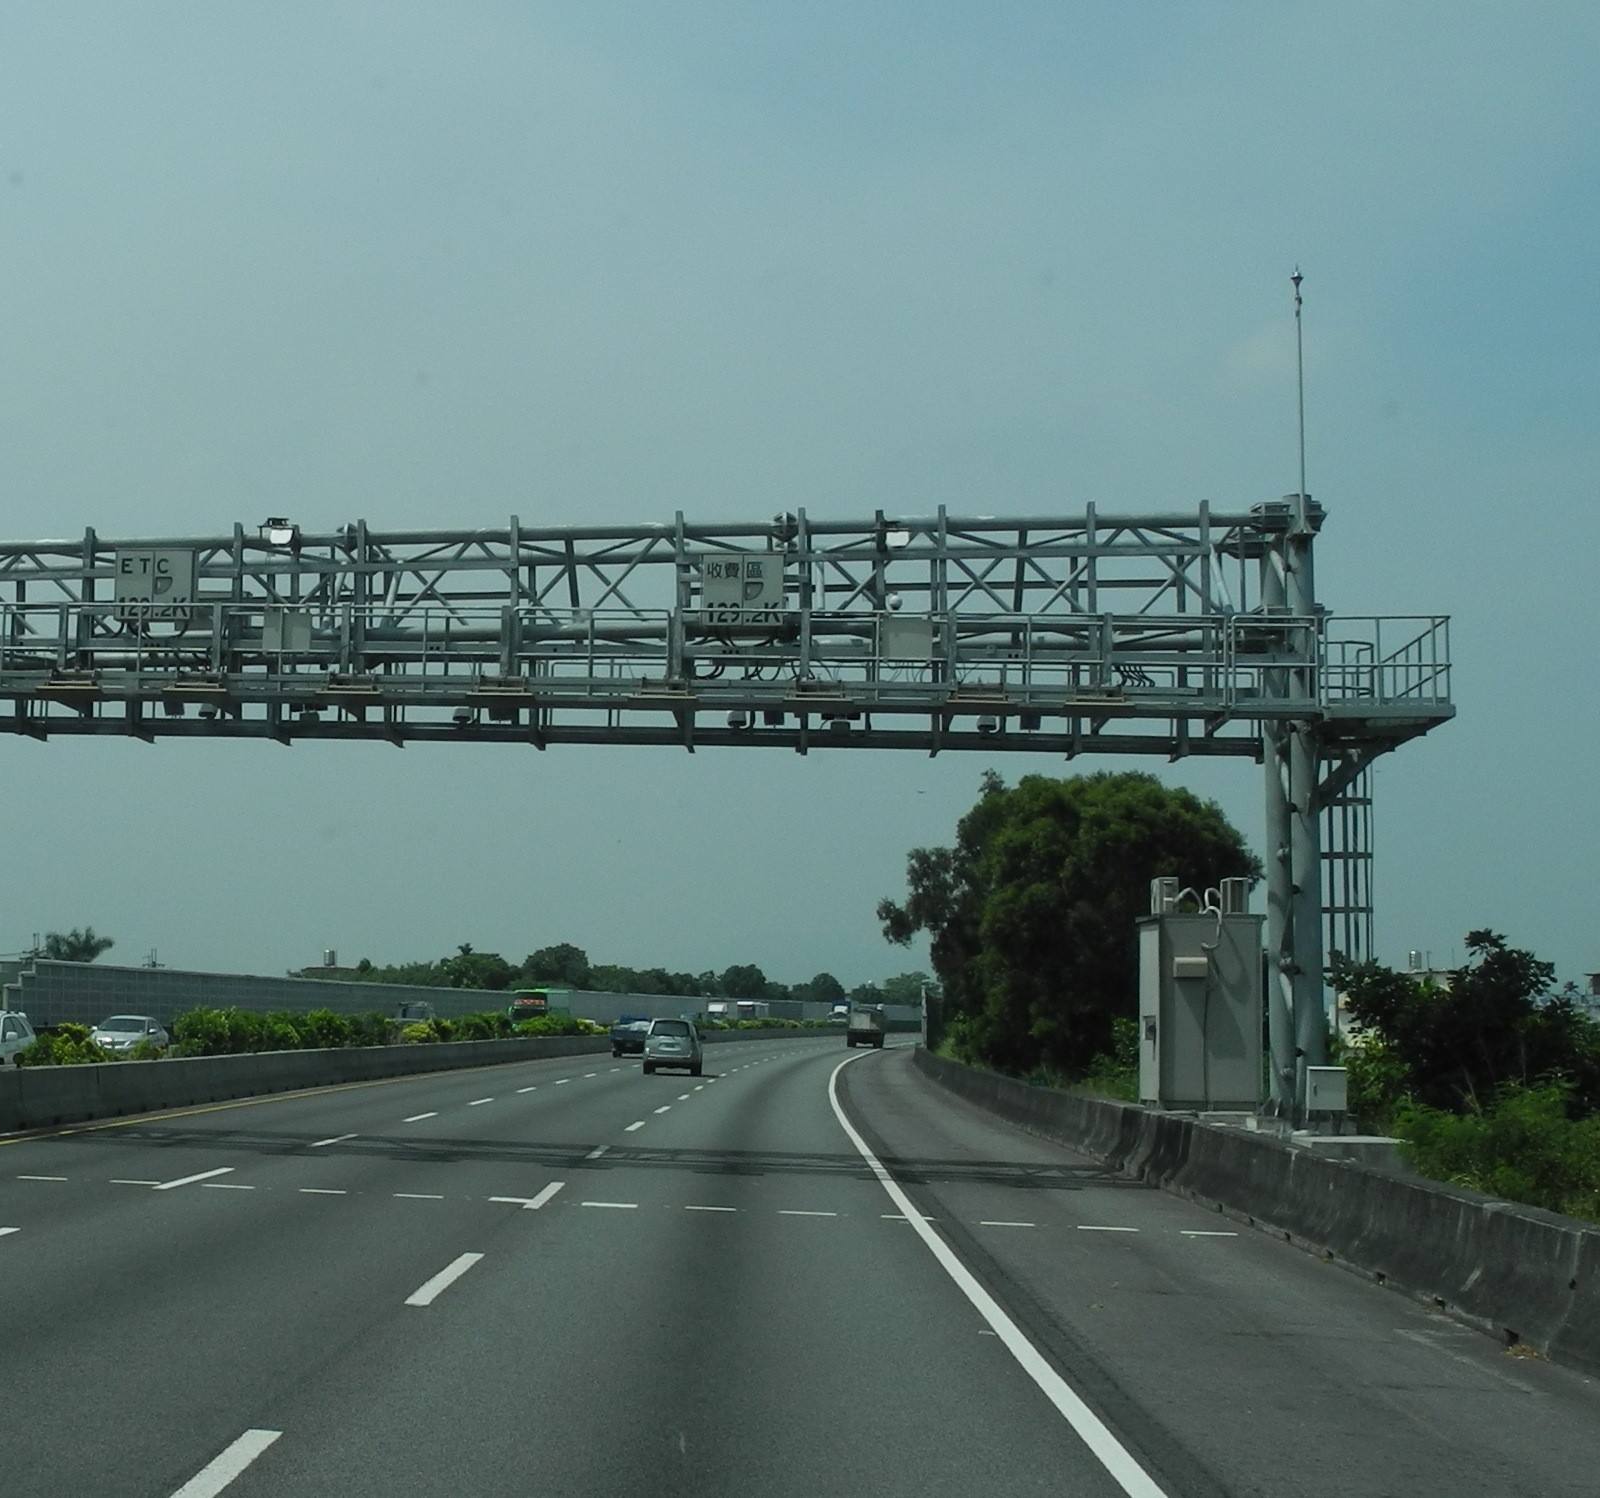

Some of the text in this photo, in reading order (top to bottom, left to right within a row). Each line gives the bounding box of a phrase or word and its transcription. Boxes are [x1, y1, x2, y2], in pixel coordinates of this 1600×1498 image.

[121, 558, 169, 574] ETC
[707, 561, 763, 579] 收費區
[706, 602, 780, 623] 129.2K
